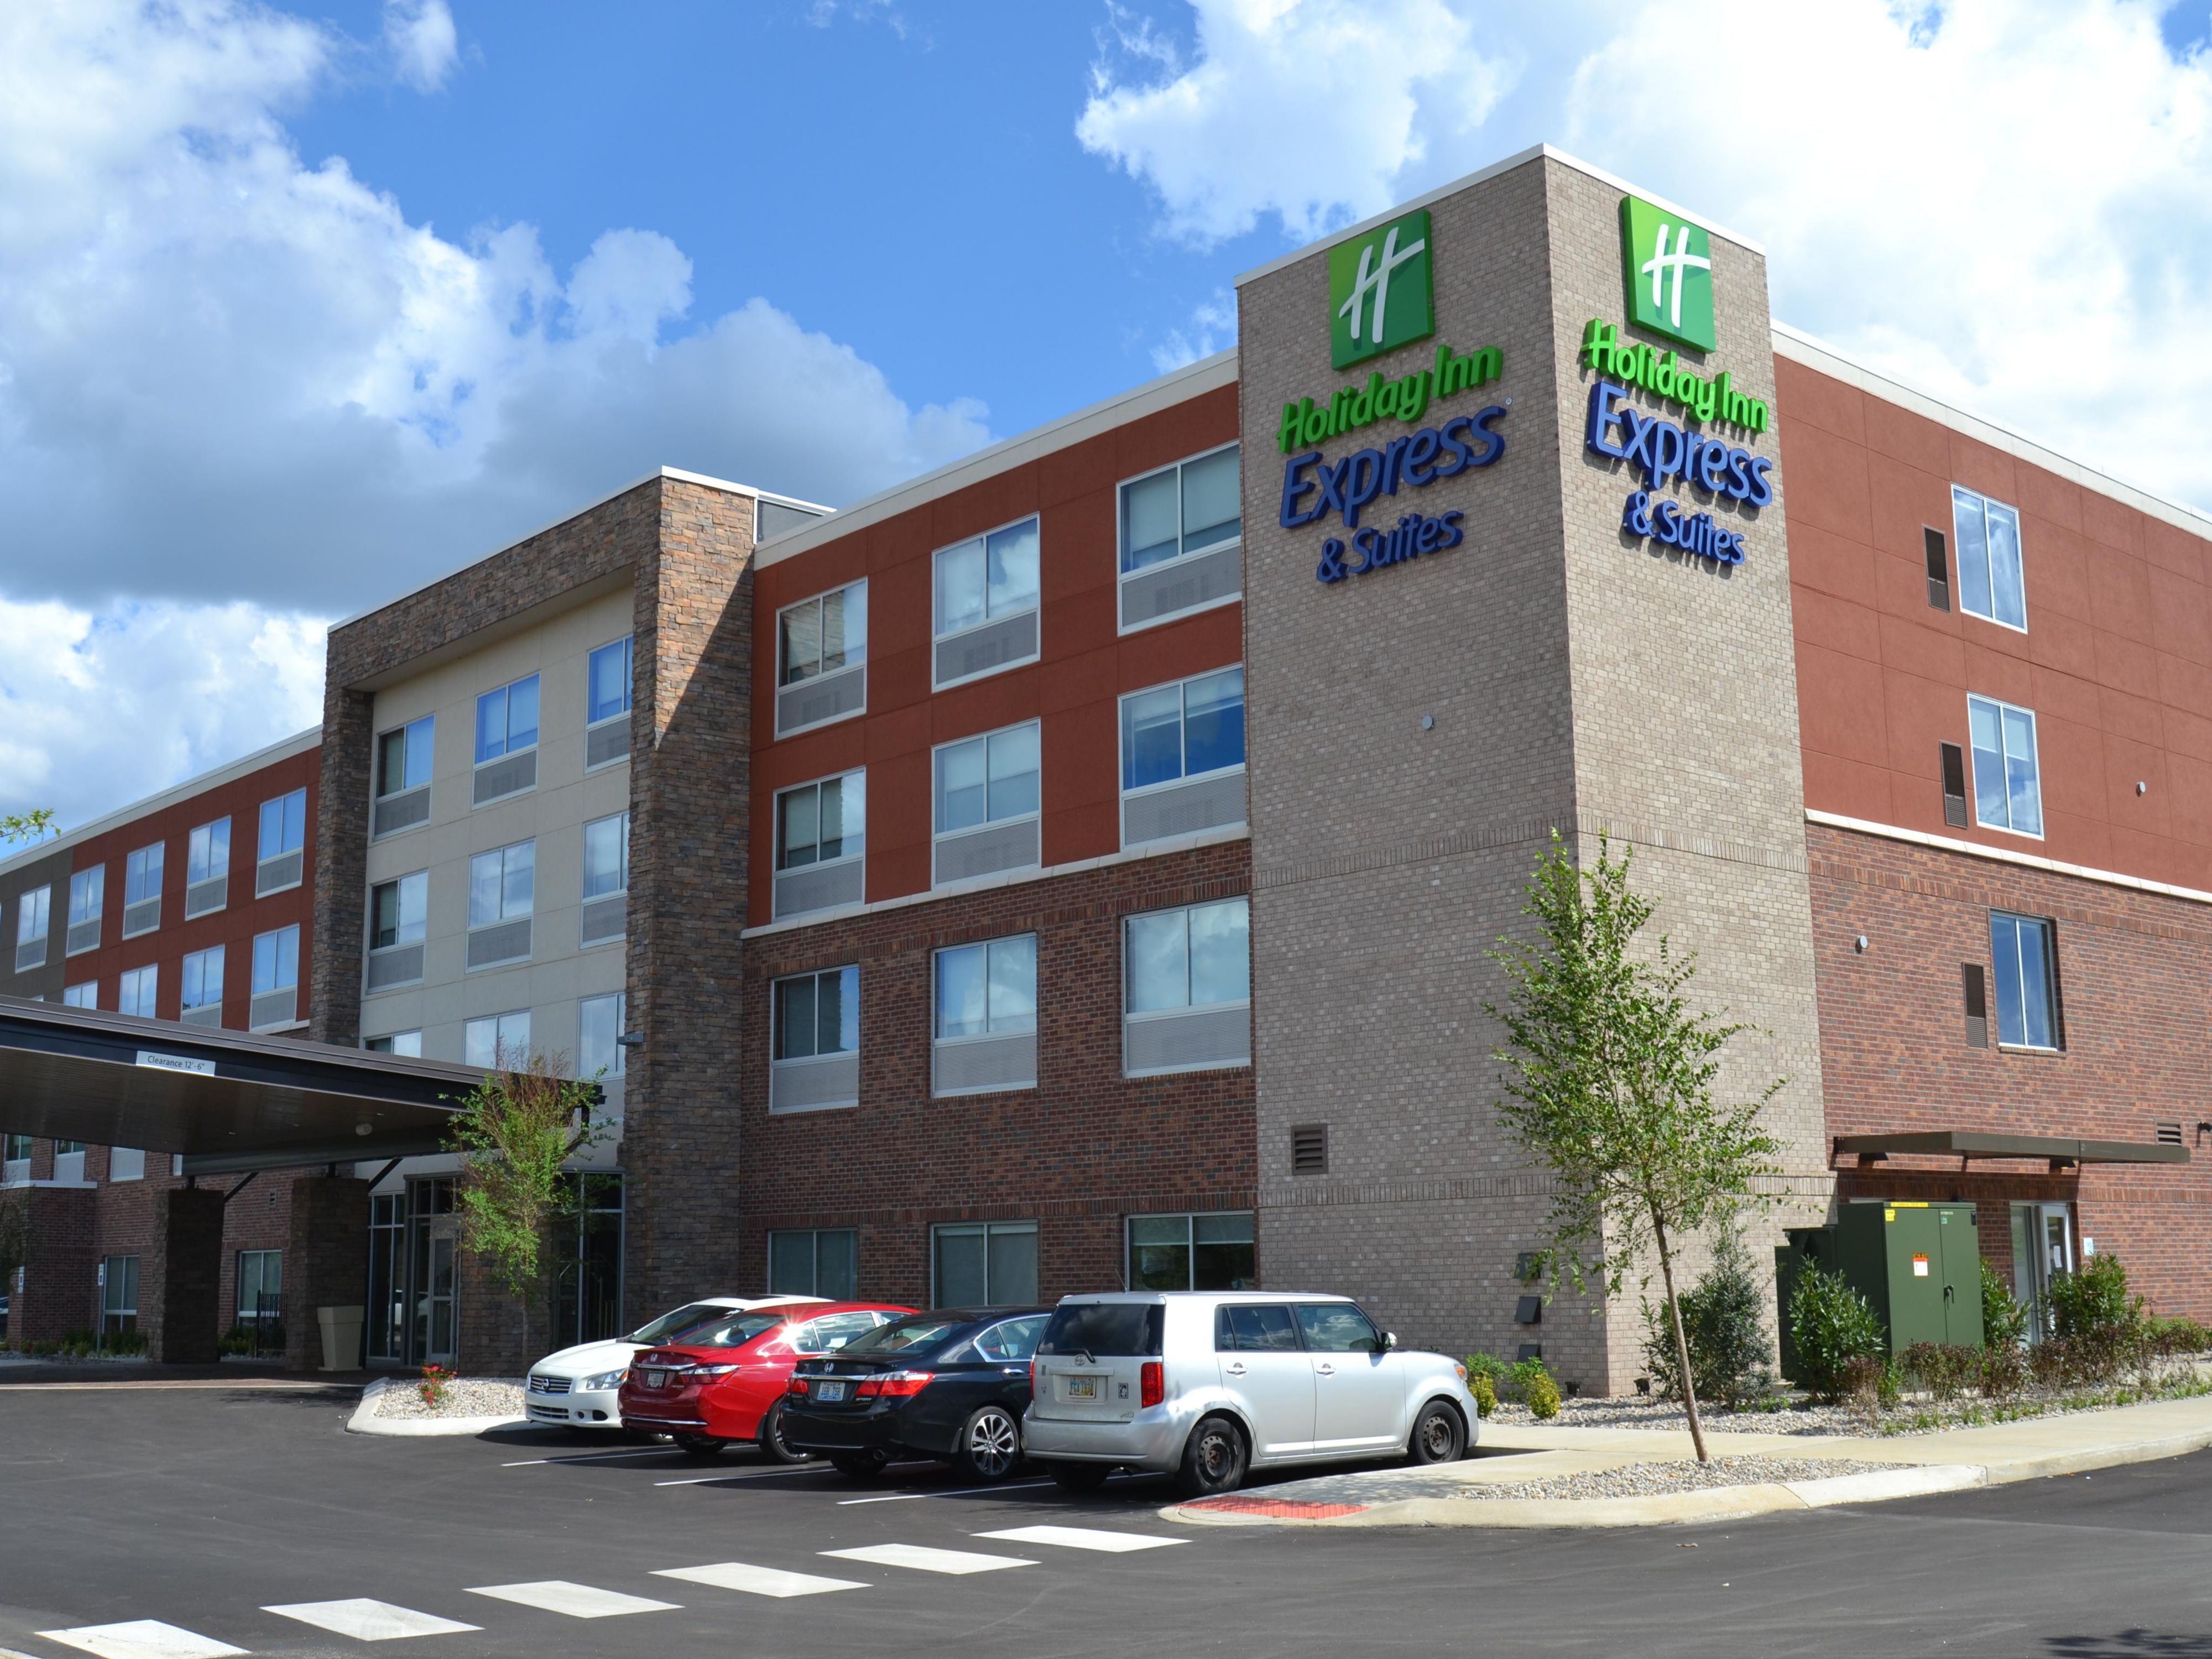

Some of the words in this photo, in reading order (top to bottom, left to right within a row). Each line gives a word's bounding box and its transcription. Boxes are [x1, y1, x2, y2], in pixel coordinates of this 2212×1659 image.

[1276, 370, 1432, 454] Holiday
[1432, 345, 1503, 399] Inn
[1580, 318, 1717, 423] Holiday
[1715, 372, 1768, 434] Inn
[1280, 406, 1507, 529] Express
[1587, 381, 1772, 508] Express
[1317, 538, 1348, 583] &
[1348, 510, 1464, 574] Suites
[1623, 490, 1655, 538] &
[1652, 500, 1745, 566] Suites
[147, 1055, 182, 1068] Clearance
